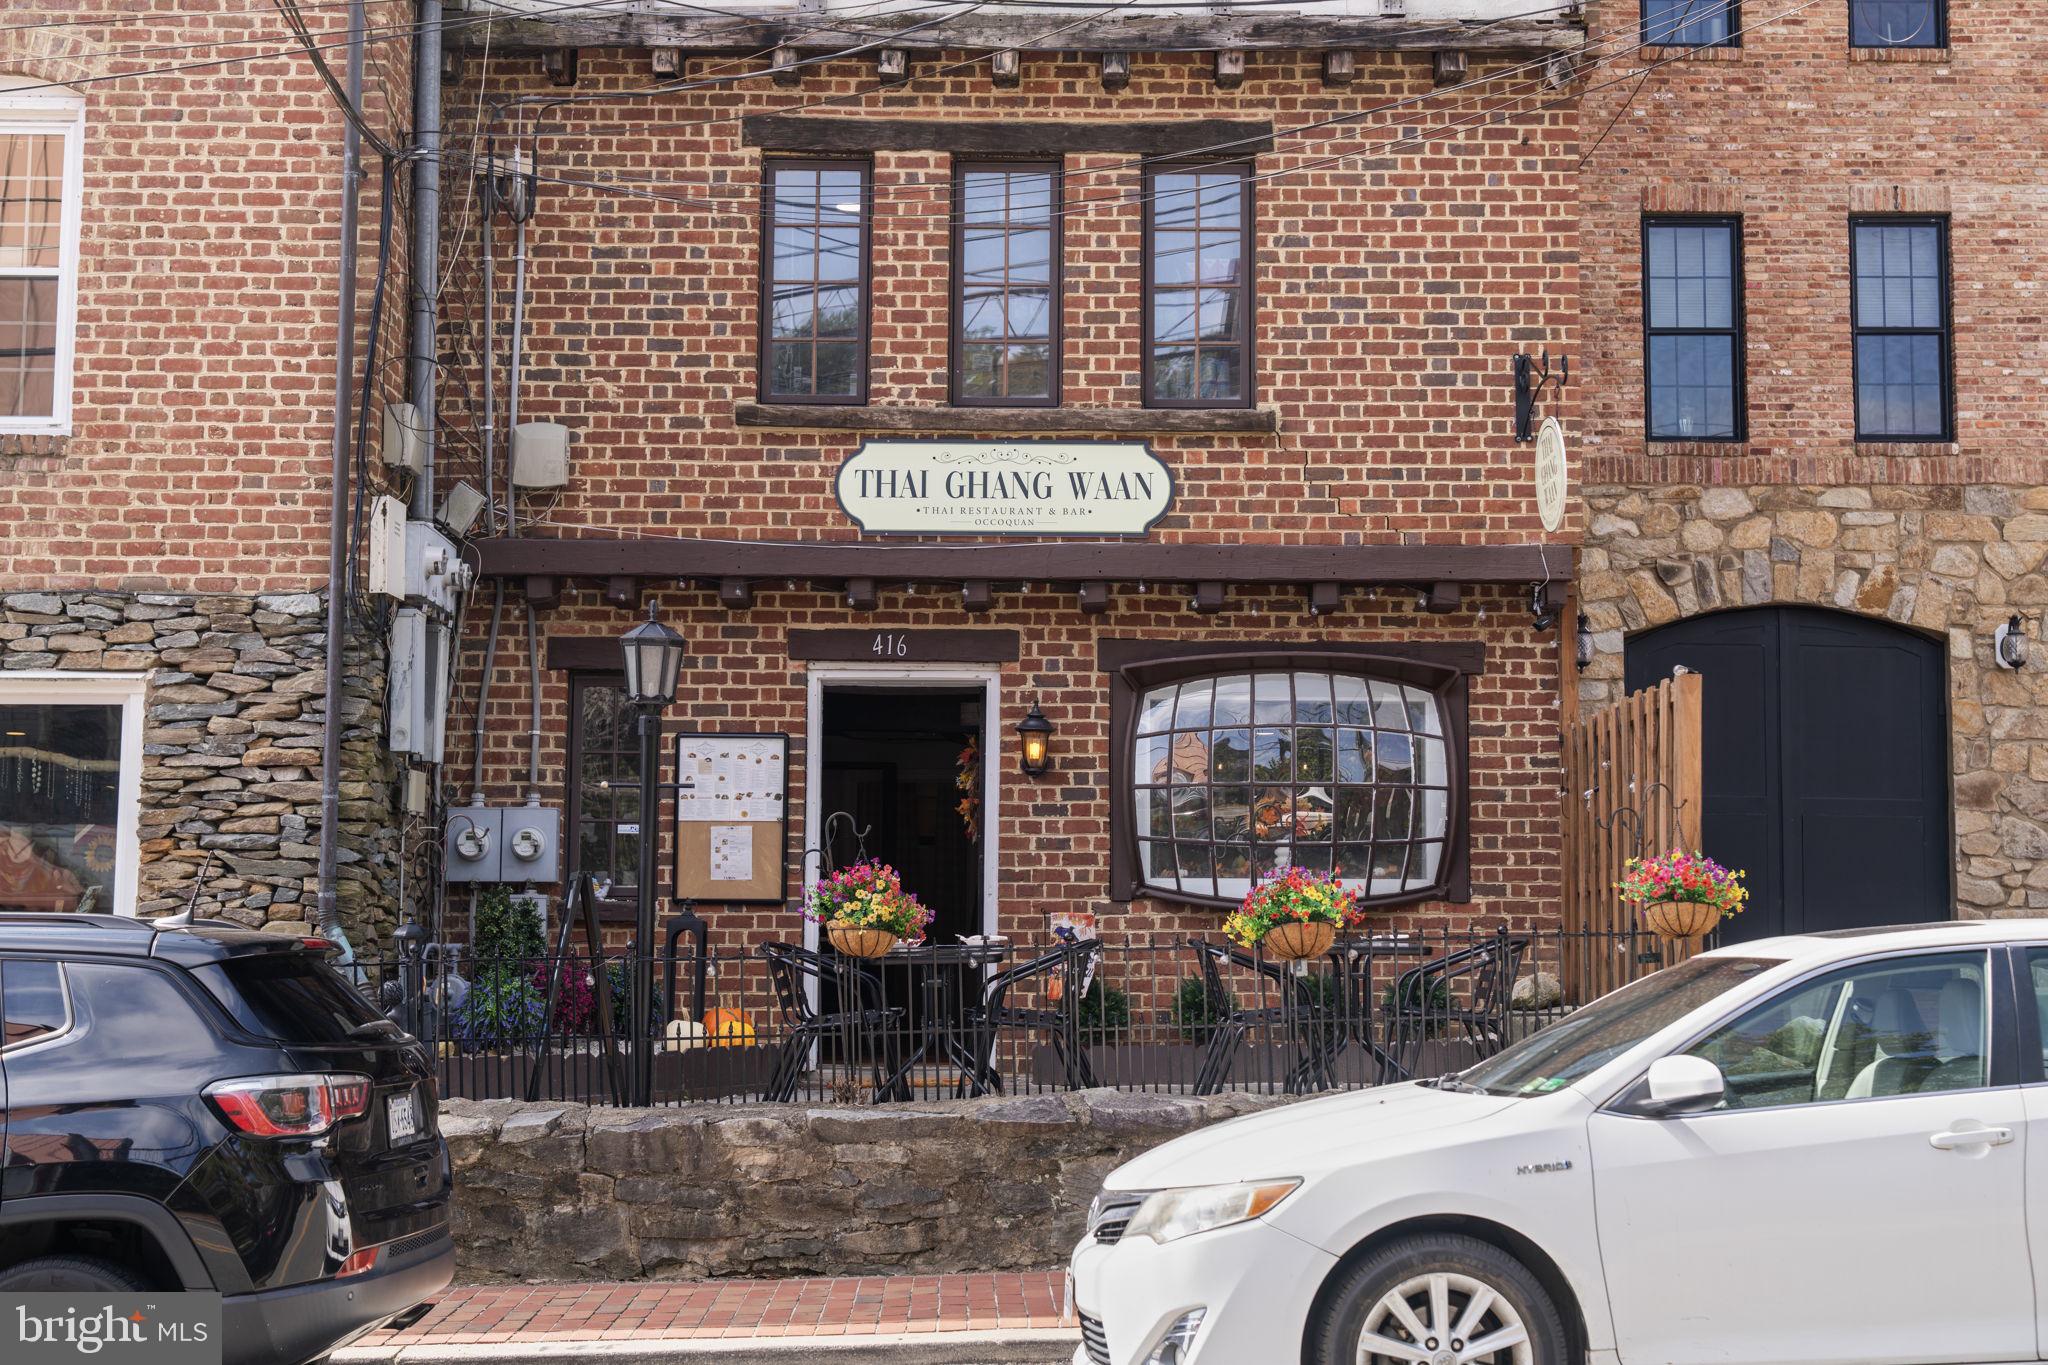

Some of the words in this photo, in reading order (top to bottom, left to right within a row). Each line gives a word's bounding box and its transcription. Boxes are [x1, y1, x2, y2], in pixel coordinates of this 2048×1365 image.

[854, 468, 930, 499] THAI
[945, 471, 1054, 500] GHANG
[1068, 471, 1155, 501] WAAN
[923, 506, 955, 516] THAI
[959, 506, 1043, 517] RESTAURANT
[1048, 507, 1057, 517] &
[1062, 508, 1086, 517] BAR
[974, 518, 1035, 528] OCCOQUAN
[872, 633, 907, 657] 416
[1516, 1162, 1564, 1175] HYBRID
